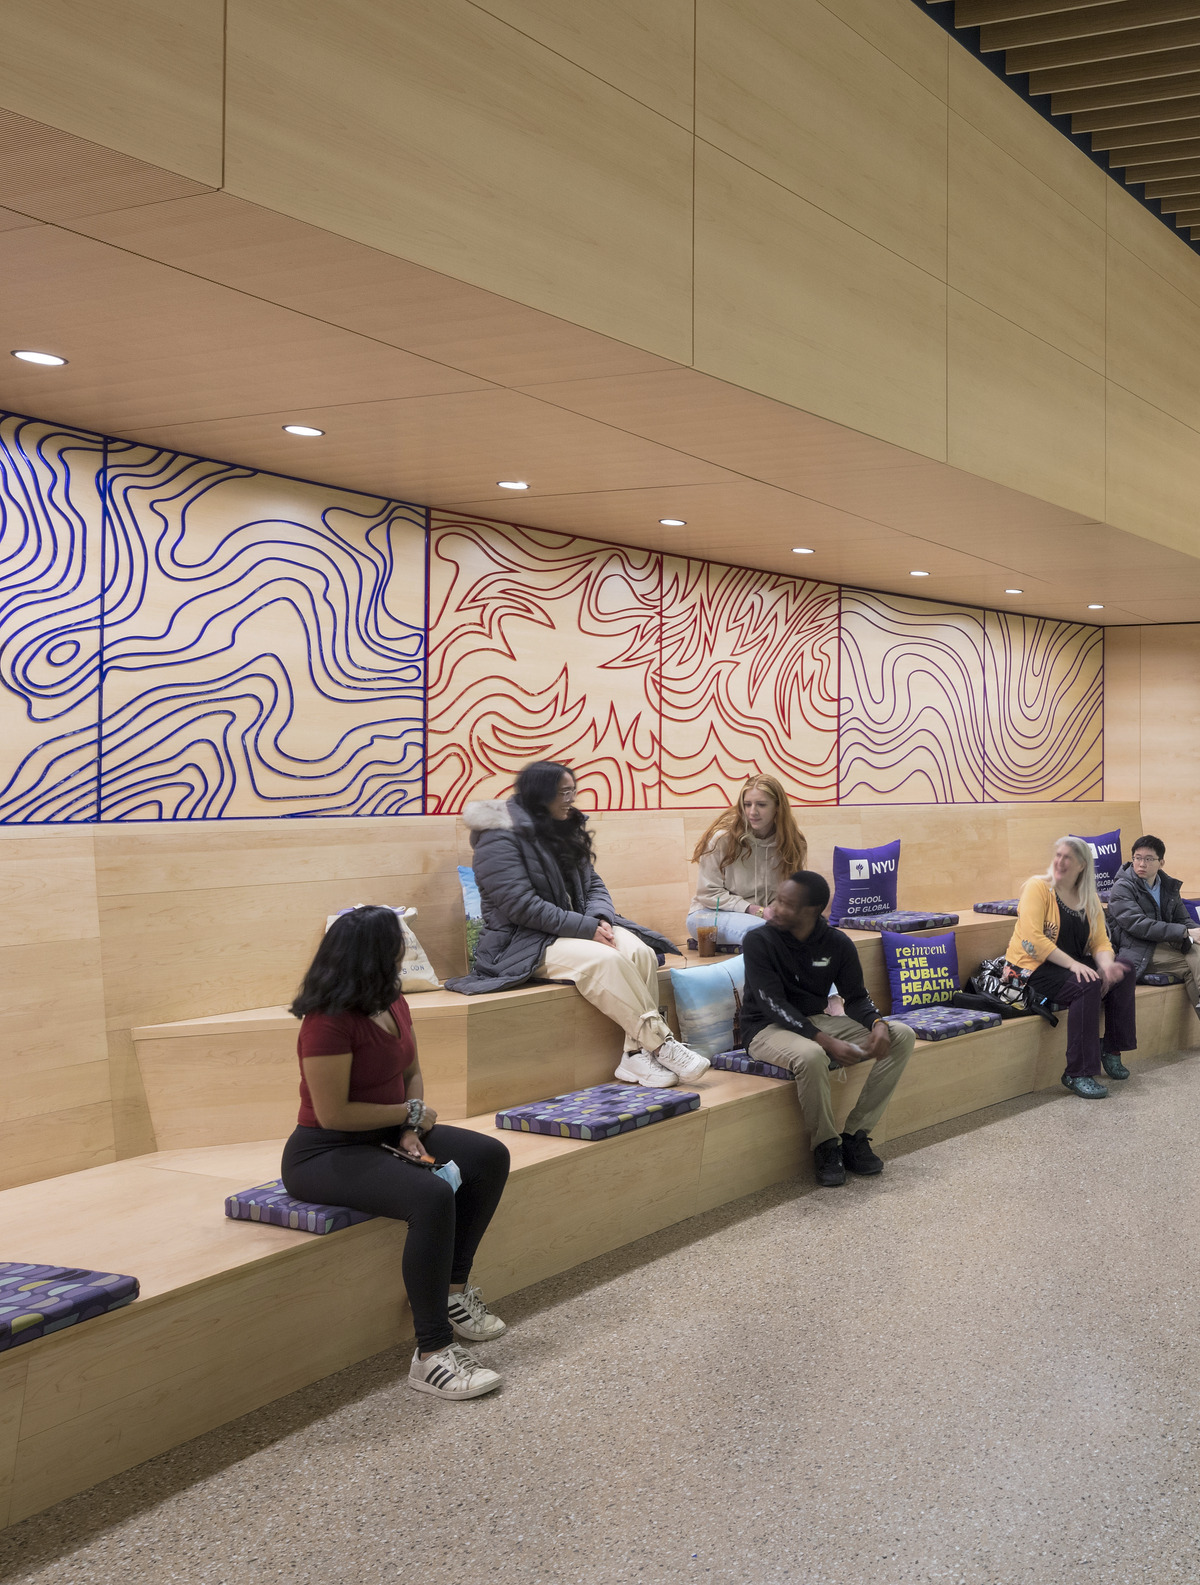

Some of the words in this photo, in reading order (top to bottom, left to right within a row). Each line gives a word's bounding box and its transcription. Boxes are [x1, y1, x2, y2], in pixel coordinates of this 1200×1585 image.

[1097, 843, 1117, 855] NYU
[871, 859, 896, 875] NYU
[848, 895, 882, 905] SCHOOL
[847, 906, 861, 914] OF
[862, 903, 890, 913] GLOBAL
[895, 944, 947, 958] reinvent
[897, 957, 929, 969] THE
[900, 966, 949, 982] PUBLIC
[901, 978, 955, 994] HEALTH
[902, 989, 963, 1006] PARADI
